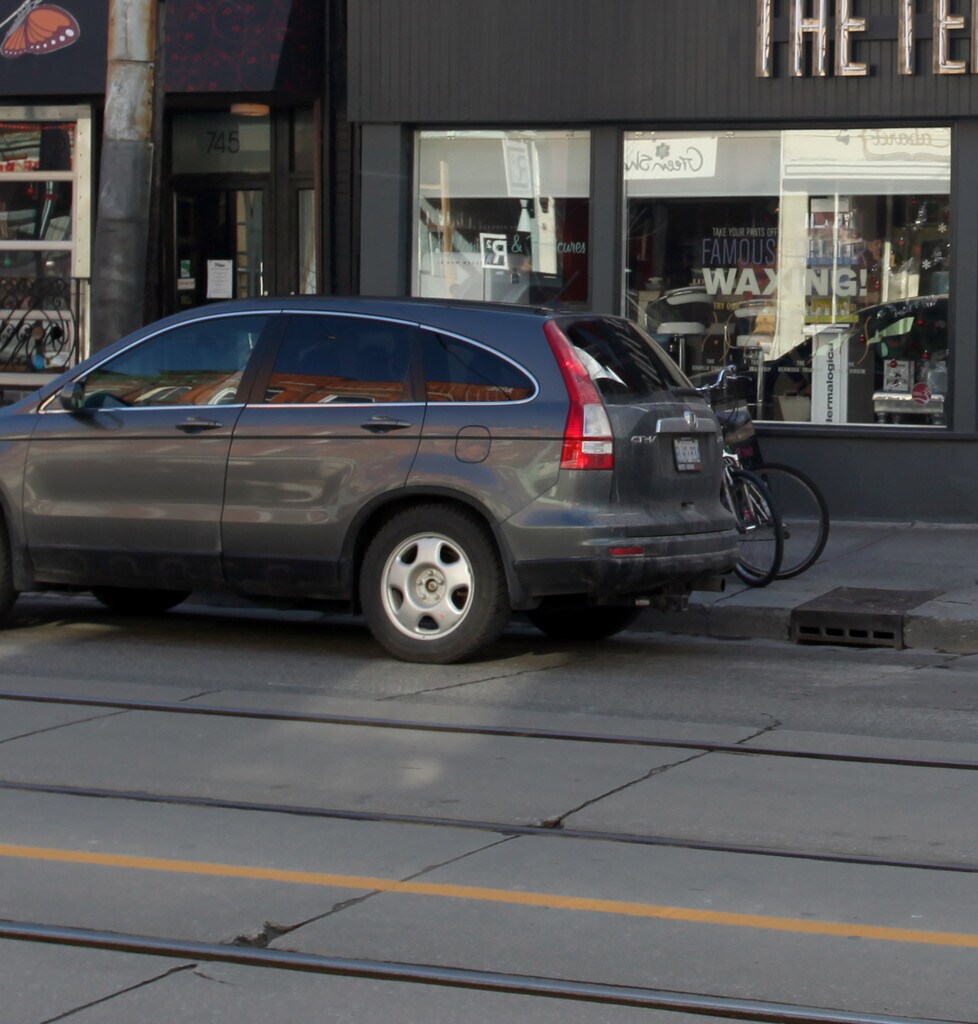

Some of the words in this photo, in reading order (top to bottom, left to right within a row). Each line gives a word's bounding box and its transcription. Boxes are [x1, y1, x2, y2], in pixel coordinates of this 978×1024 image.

[206, 130, 240, 154] 745
[712, 227, 727, 237] TAKE
[728, 227, 746, 237] YOUR
[747, 227, 765, 237] PANTS
[702, 238, 776, 265] FAMOUS
[702, 267, 868, 297] WAXING!
